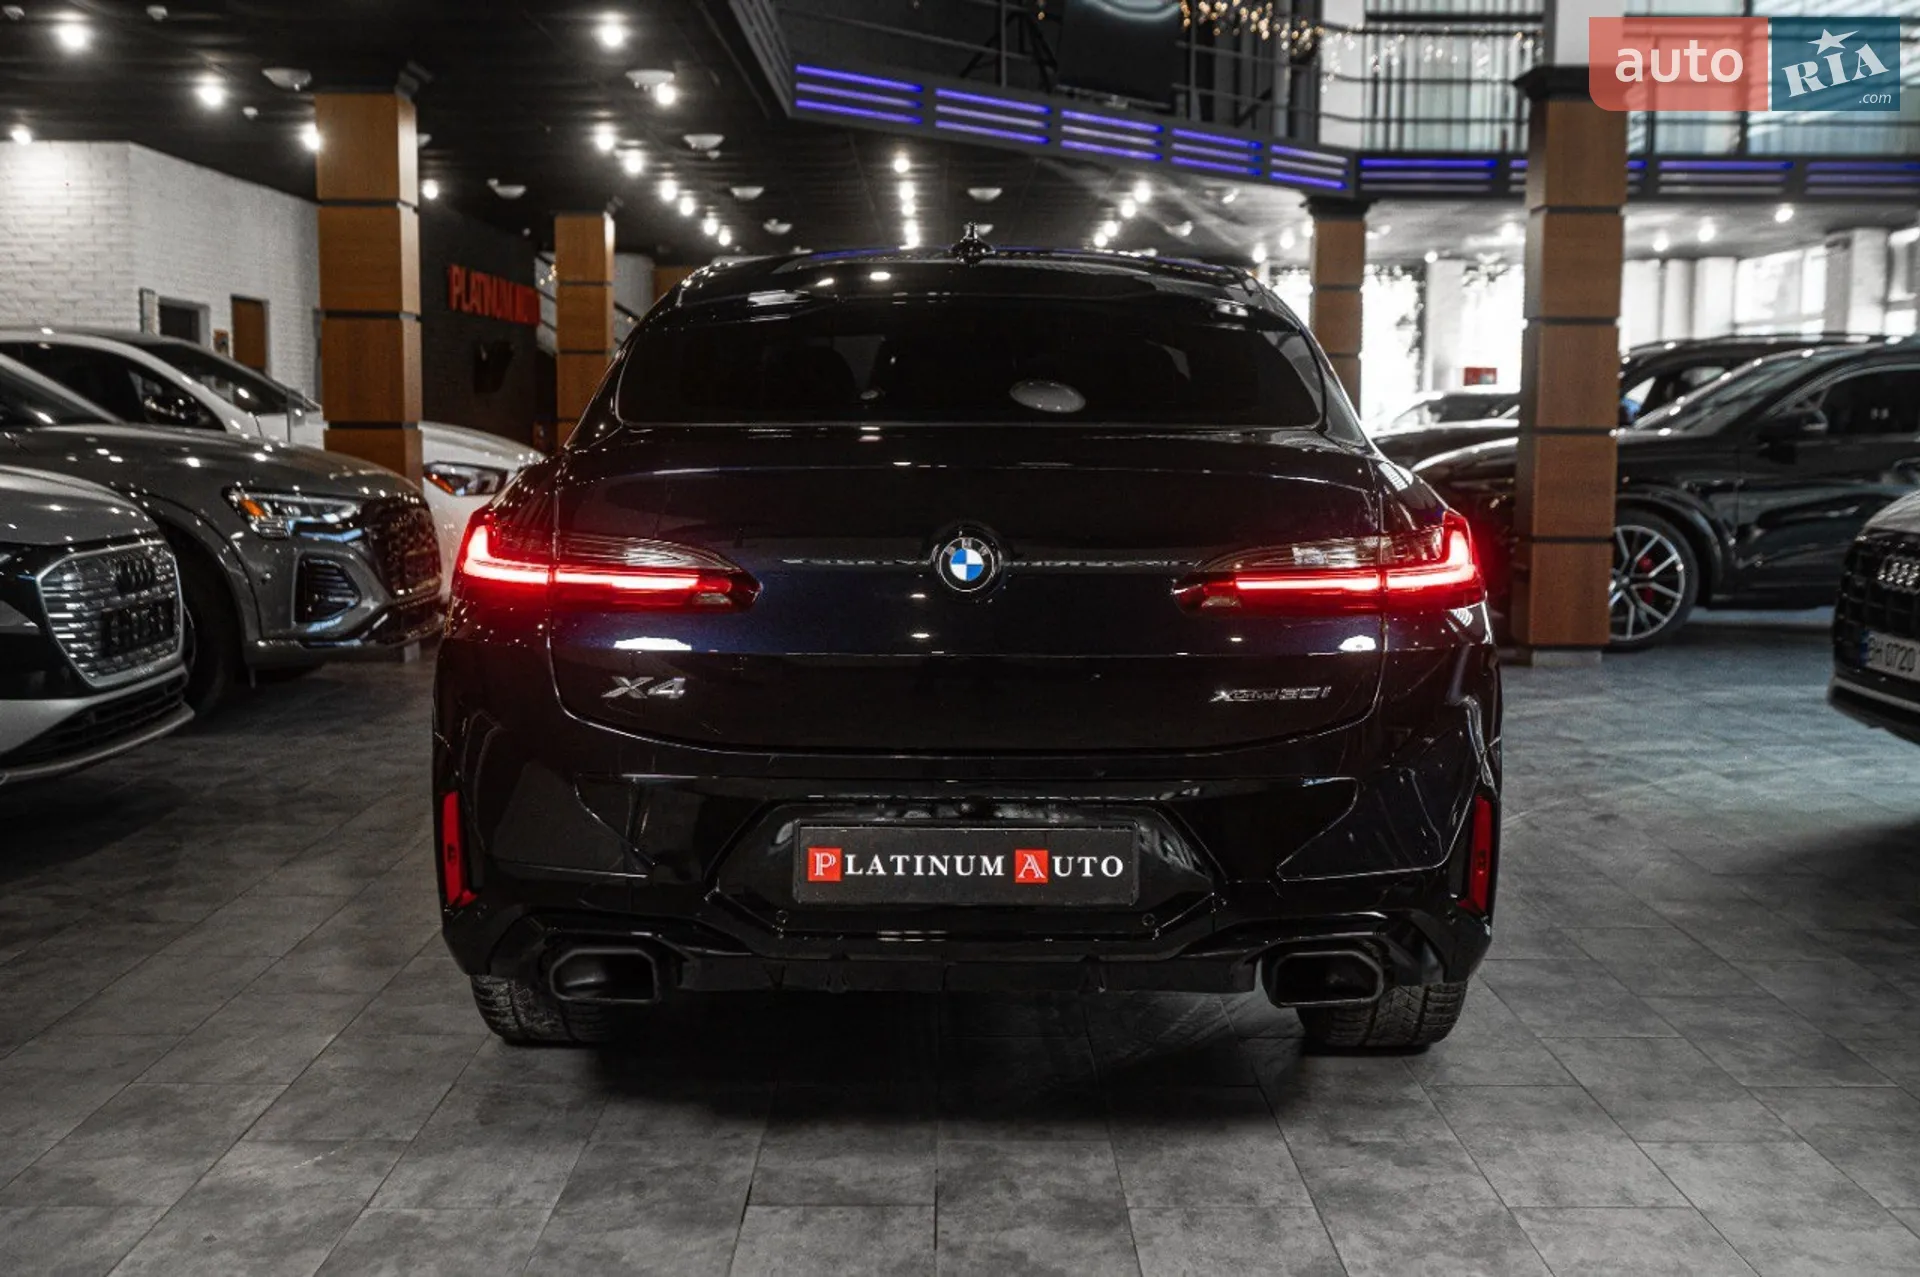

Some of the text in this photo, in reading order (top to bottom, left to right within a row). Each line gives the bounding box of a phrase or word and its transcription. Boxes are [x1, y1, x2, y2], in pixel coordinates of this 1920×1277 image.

[601, 676, 686, 699] X4
[812, 851, 1124, 879] PLATINUM AUTO
